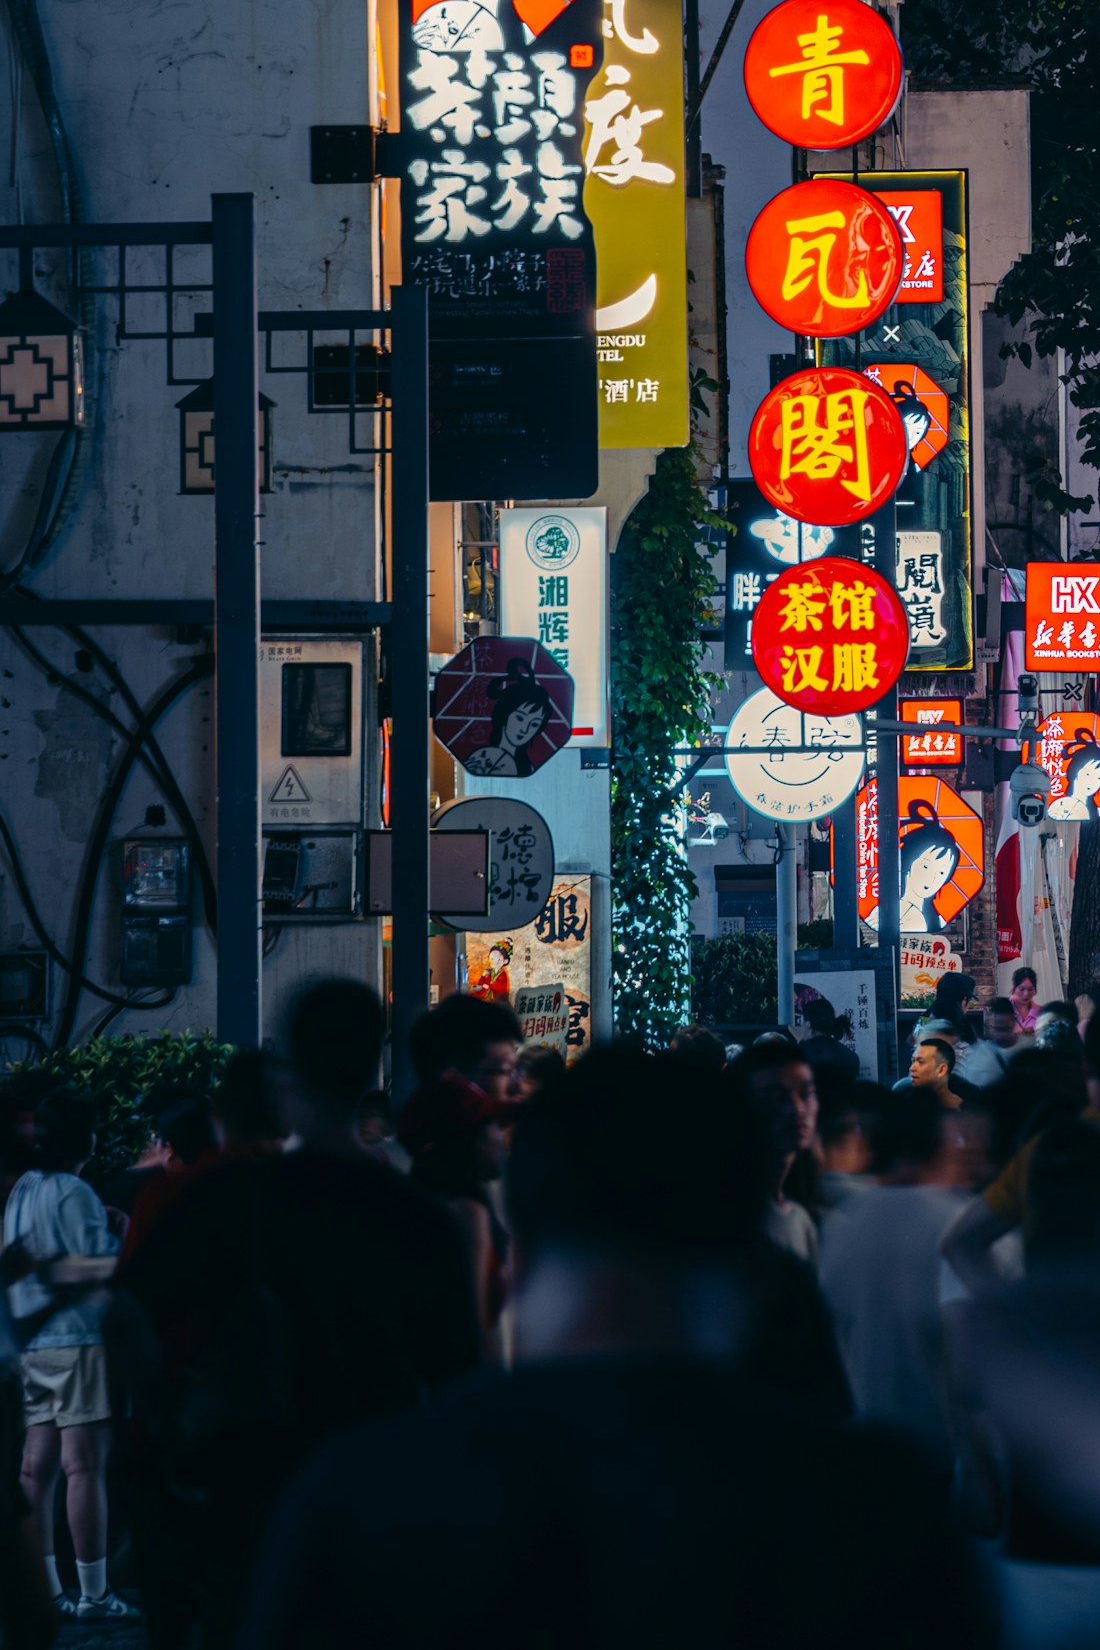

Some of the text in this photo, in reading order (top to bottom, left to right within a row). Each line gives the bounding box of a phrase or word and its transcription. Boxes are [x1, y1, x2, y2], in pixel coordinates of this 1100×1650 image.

[407, 140, 584, 243] 家族
[779, 580, 876, 633] 茶馆
[1052, 577, 1100, 613] HX
[779, 641, 879, 694] 汉服
[1034, 650, 1065, 658] XINHUA
